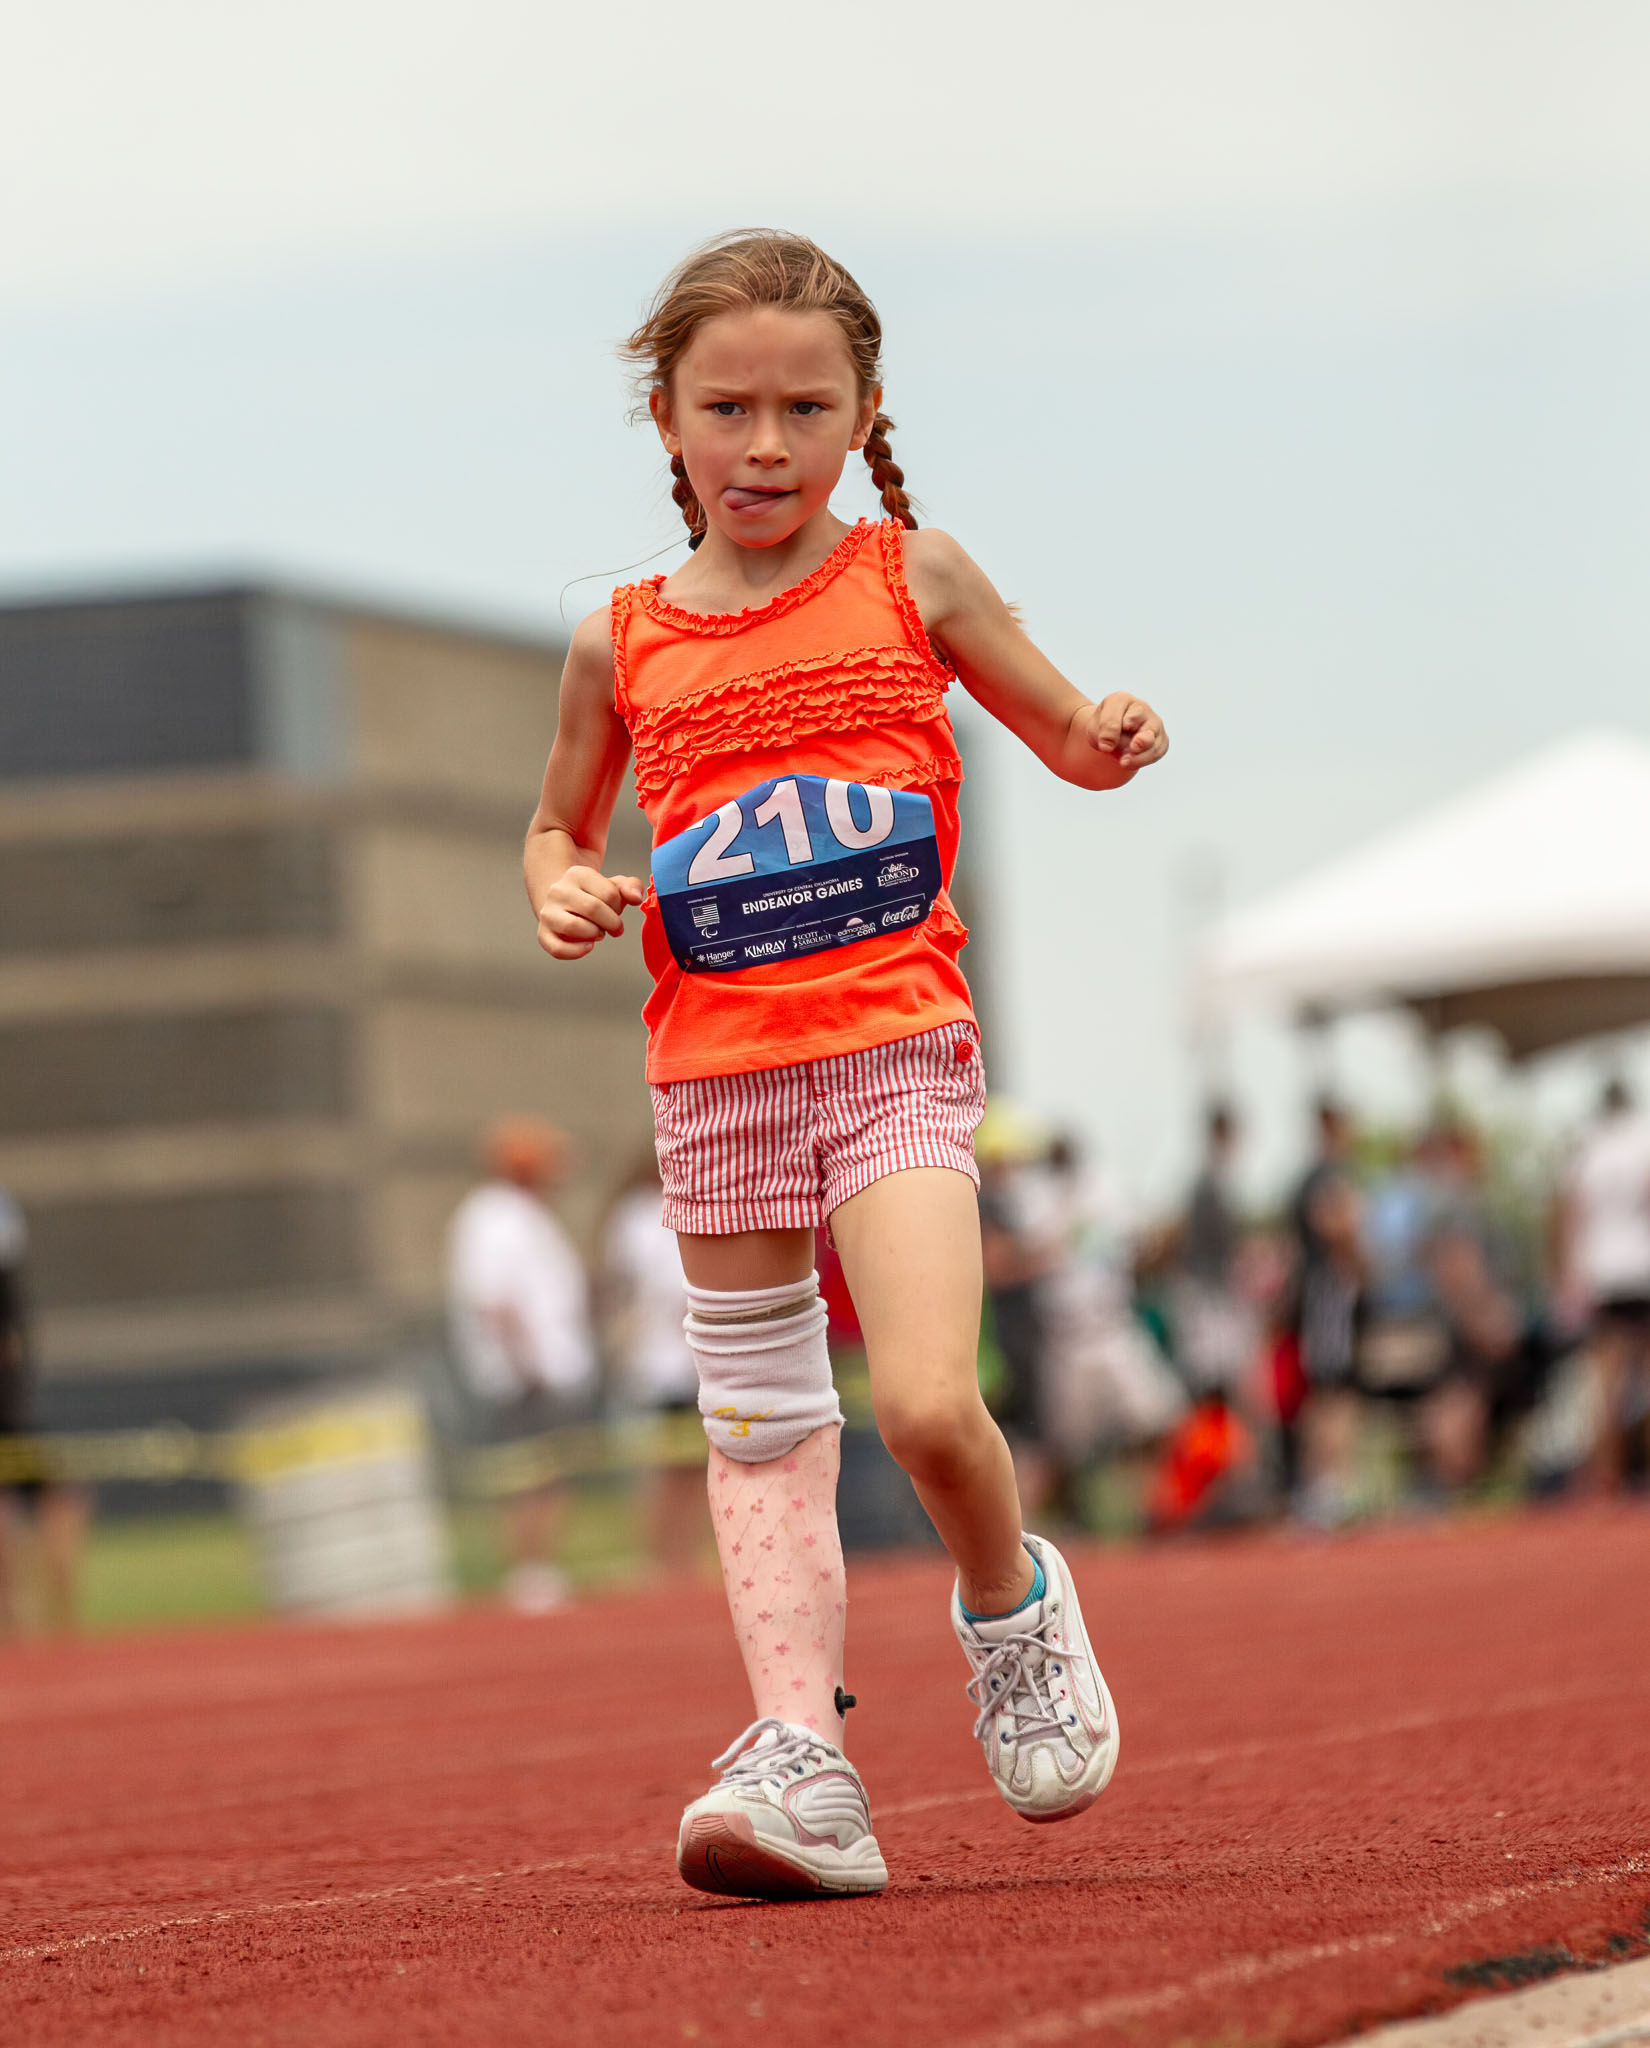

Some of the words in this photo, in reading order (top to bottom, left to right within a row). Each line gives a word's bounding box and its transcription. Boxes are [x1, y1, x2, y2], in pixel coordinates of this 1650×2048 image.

[687, 777, 895, 886] 210
[877, 867, 920, 887] EDMOND
[742, 890, 813, 915] ENDEAVOR
[816, 877, 864, 899] GAMES
[794, 884, 813, 892] CENTRAL
[797, 930, 818, 940] SCOTT
[798, 933, 833, 946] SABOLICH
[706, 949, 736, 961] Hanger
[744, 939, 787, 958] KIMRAY
